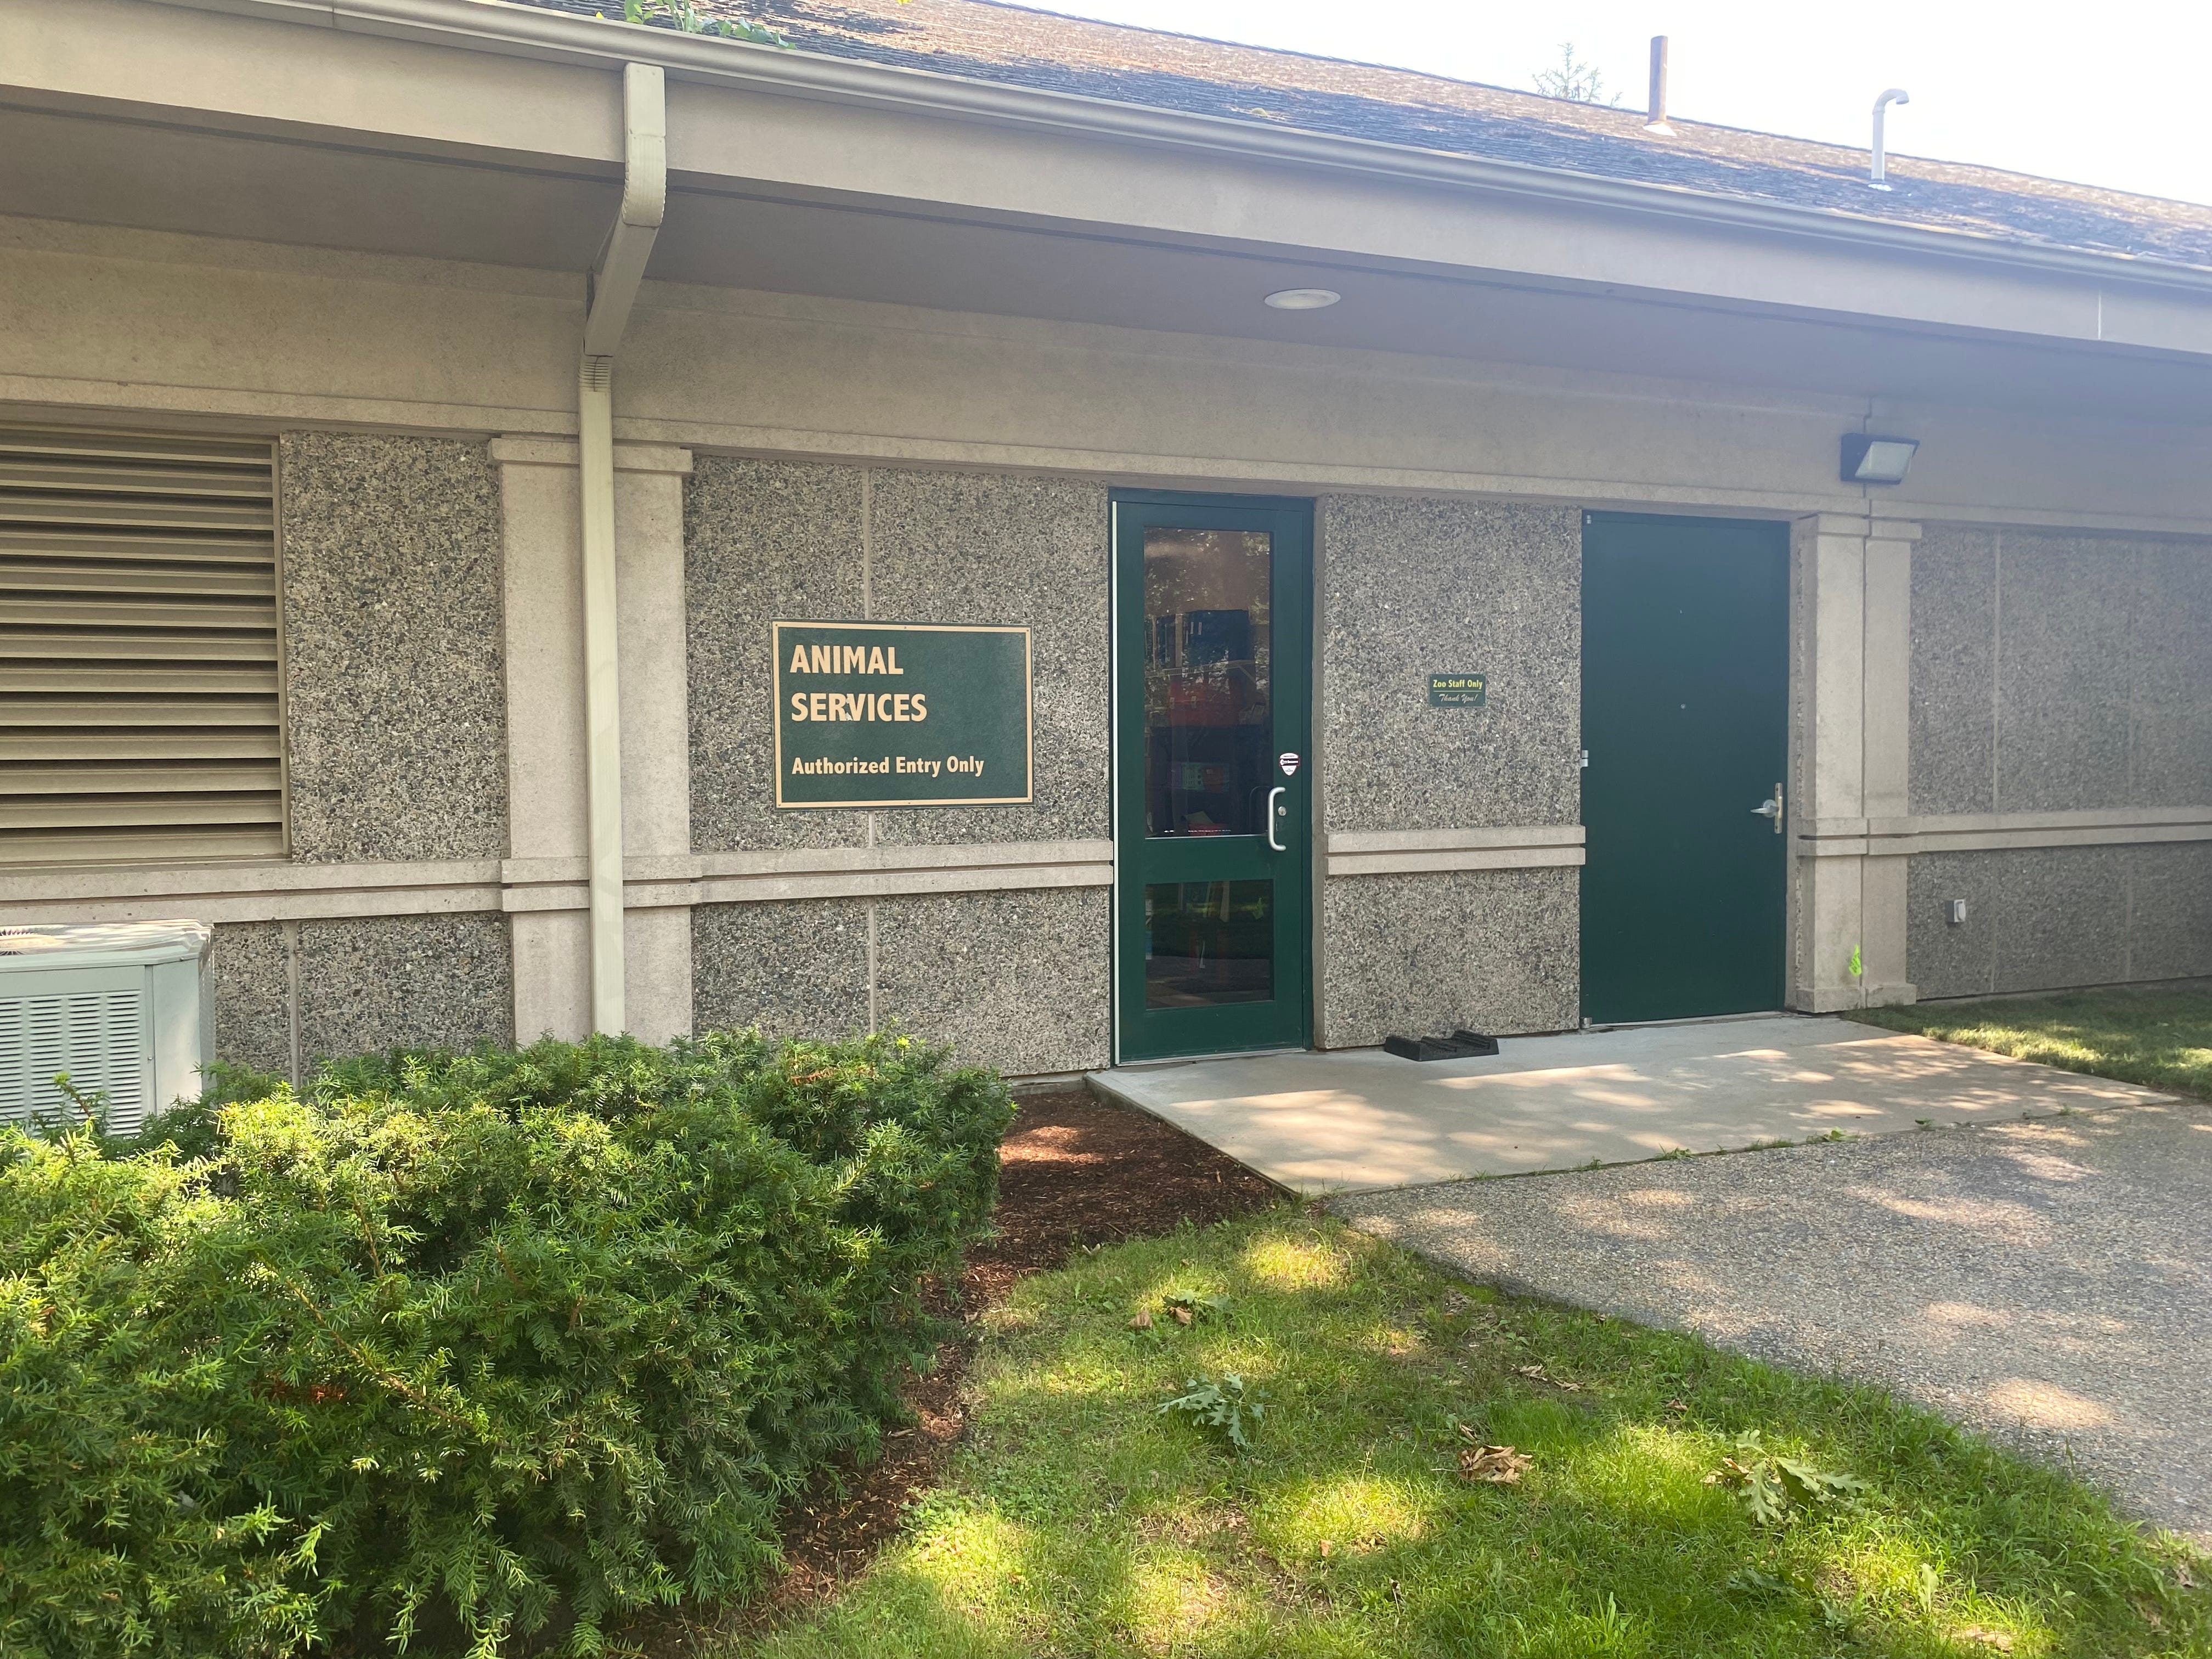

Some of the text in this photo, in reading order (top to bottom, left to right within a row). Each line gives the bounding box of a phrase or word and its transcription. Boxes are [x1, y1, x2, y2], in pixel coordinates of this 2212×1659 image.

[789, 645, 904, 675] ANIMAL
[1433, 679, 1482, 689] Zoo Staff Only
[791, 692, 928, 722] SERVICES
[1439, 693, 1478, 703] Thank You!
[792, 755, 985, 778] Authorized Entry Only
